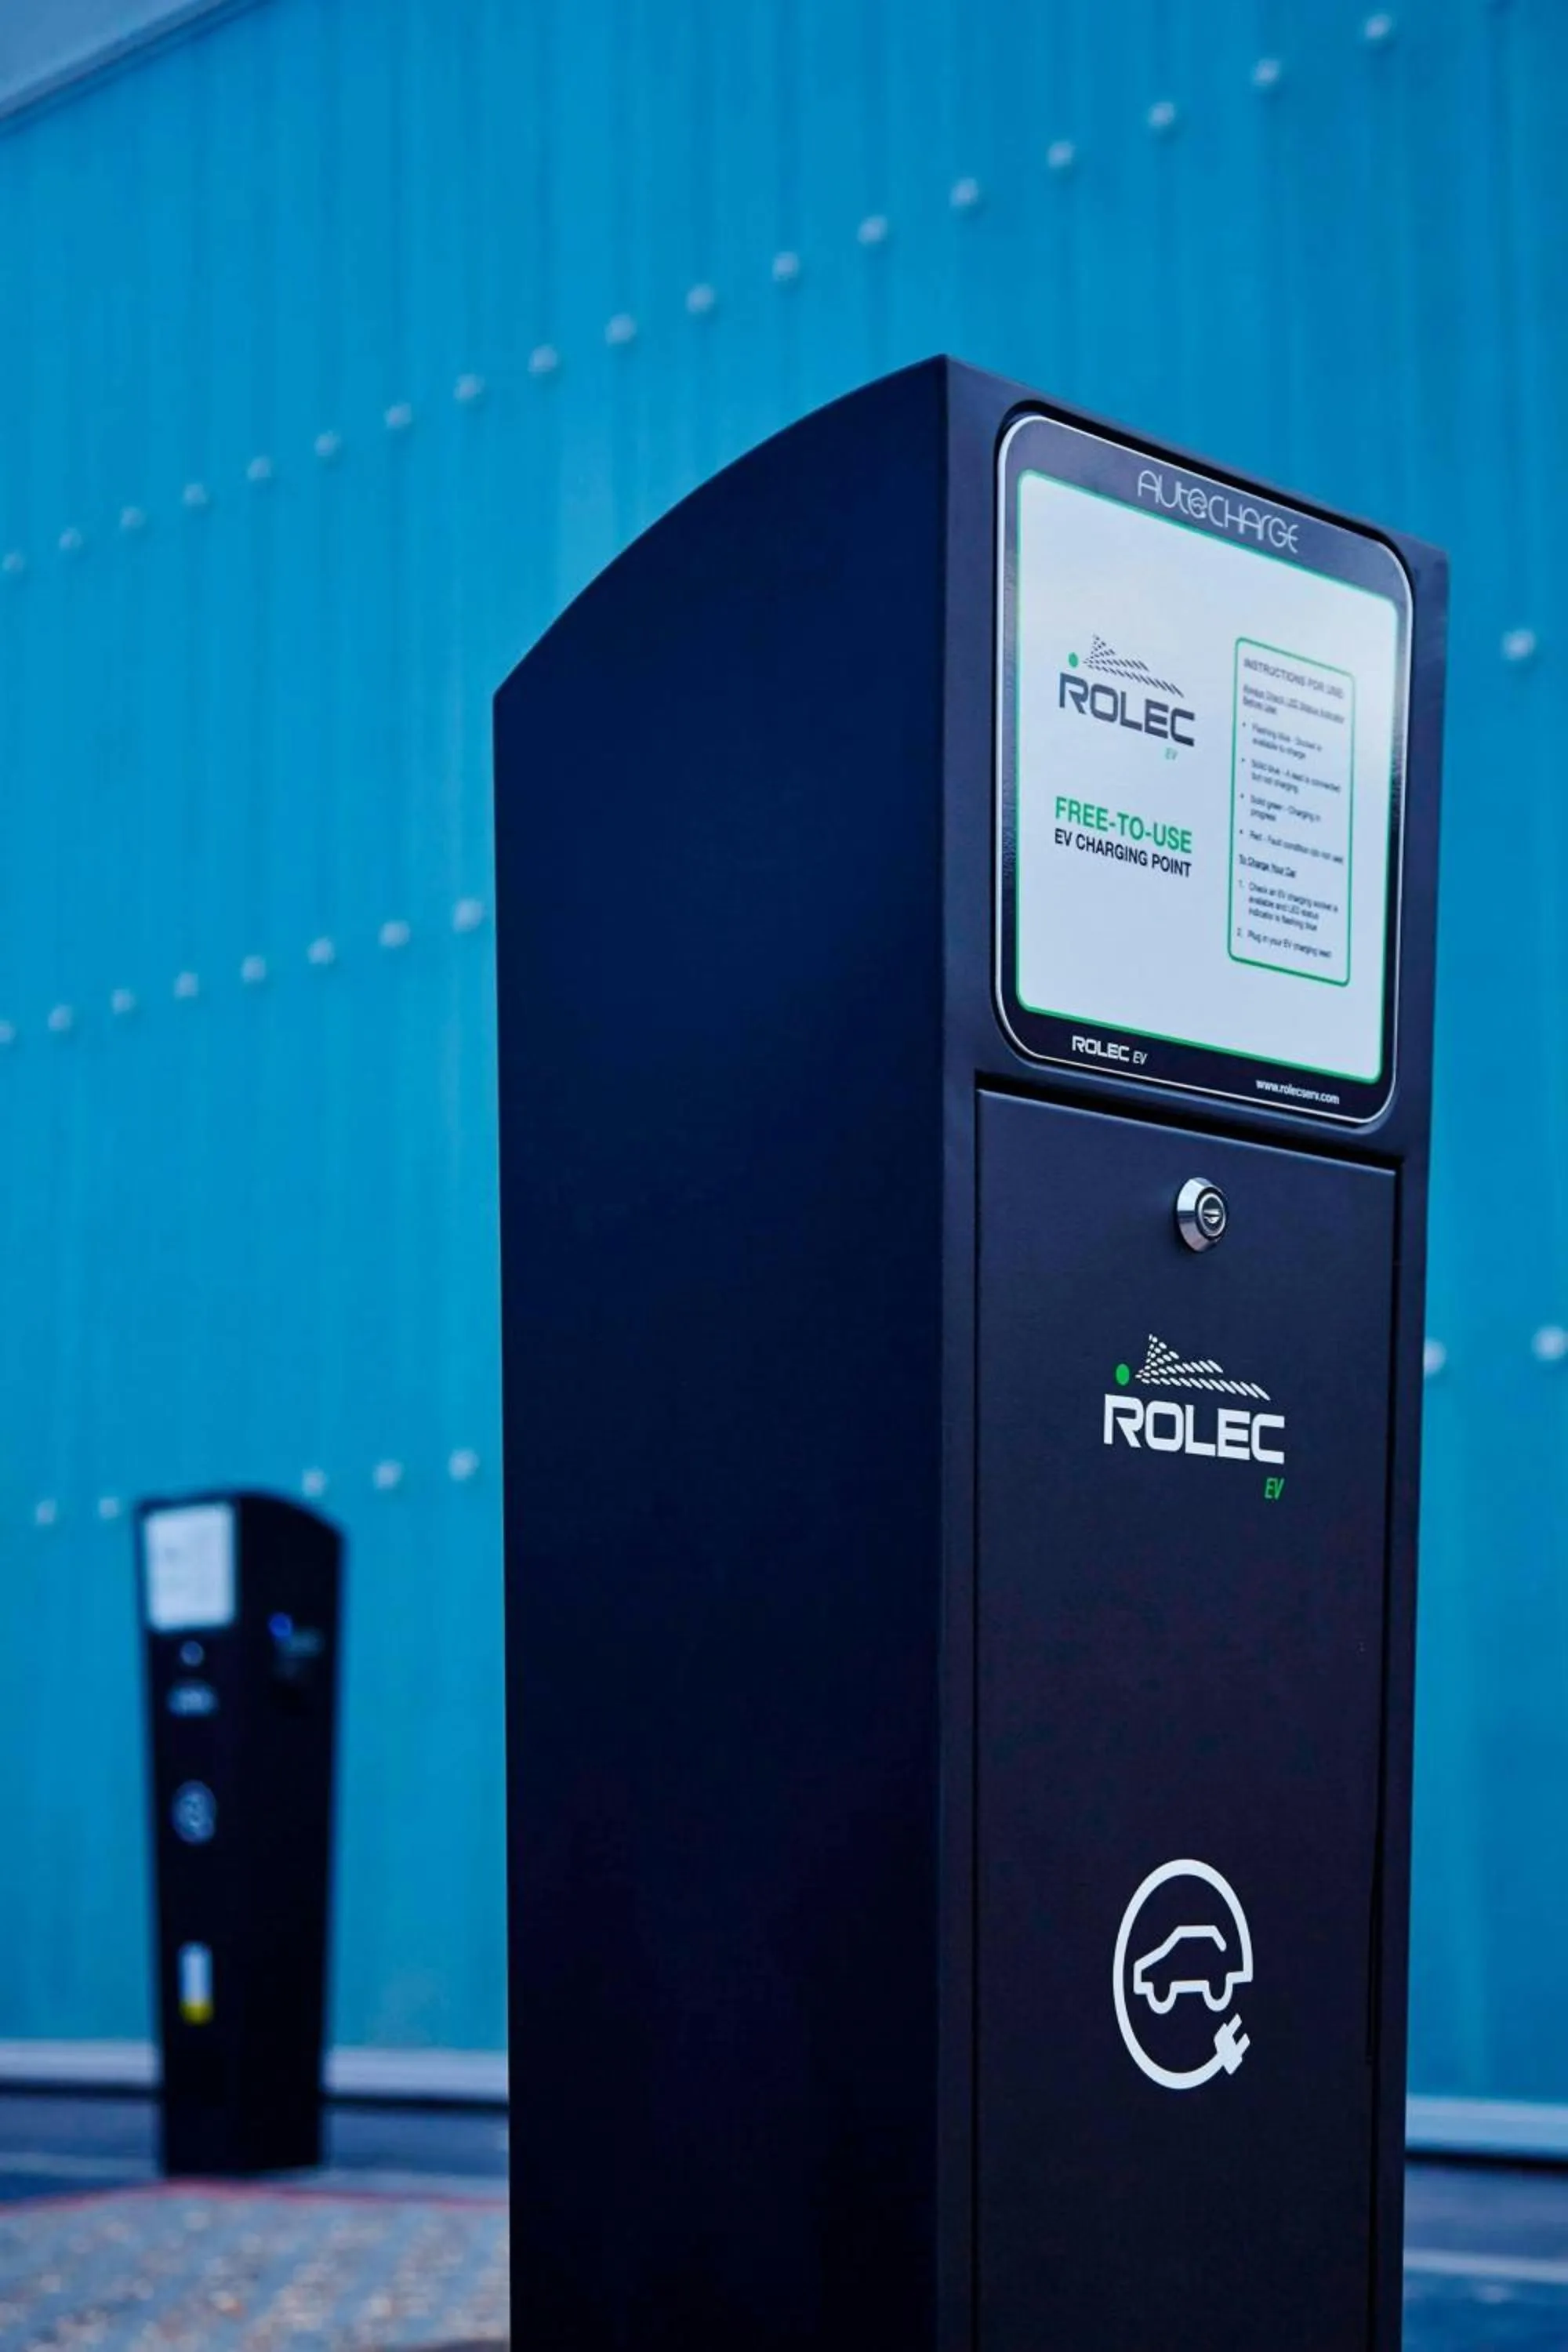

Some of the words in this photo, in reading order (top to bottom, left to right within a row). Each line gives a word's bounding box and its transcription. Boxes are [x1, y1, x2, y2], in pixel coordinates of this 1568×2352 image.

[1058, 672, 1195, 747] ROLEC
[1055, 797, 1192, 854] FREE-TO-USE
[1054, 829, 1073, 847] EV
[1076, 833, 1149, 867] CHARGING
[1151, 853, 1192, 877] POINT
[1072, 1035, 1130, 1062] ROLEC
[1133, 1051, 1148, 1065] EV
[1255, 1080, 1340, 1105] www.rolecserv.com
[1103, 1393, 1285, 1465] ROLEC
[1265, 1477, 1285, 1499] EV
